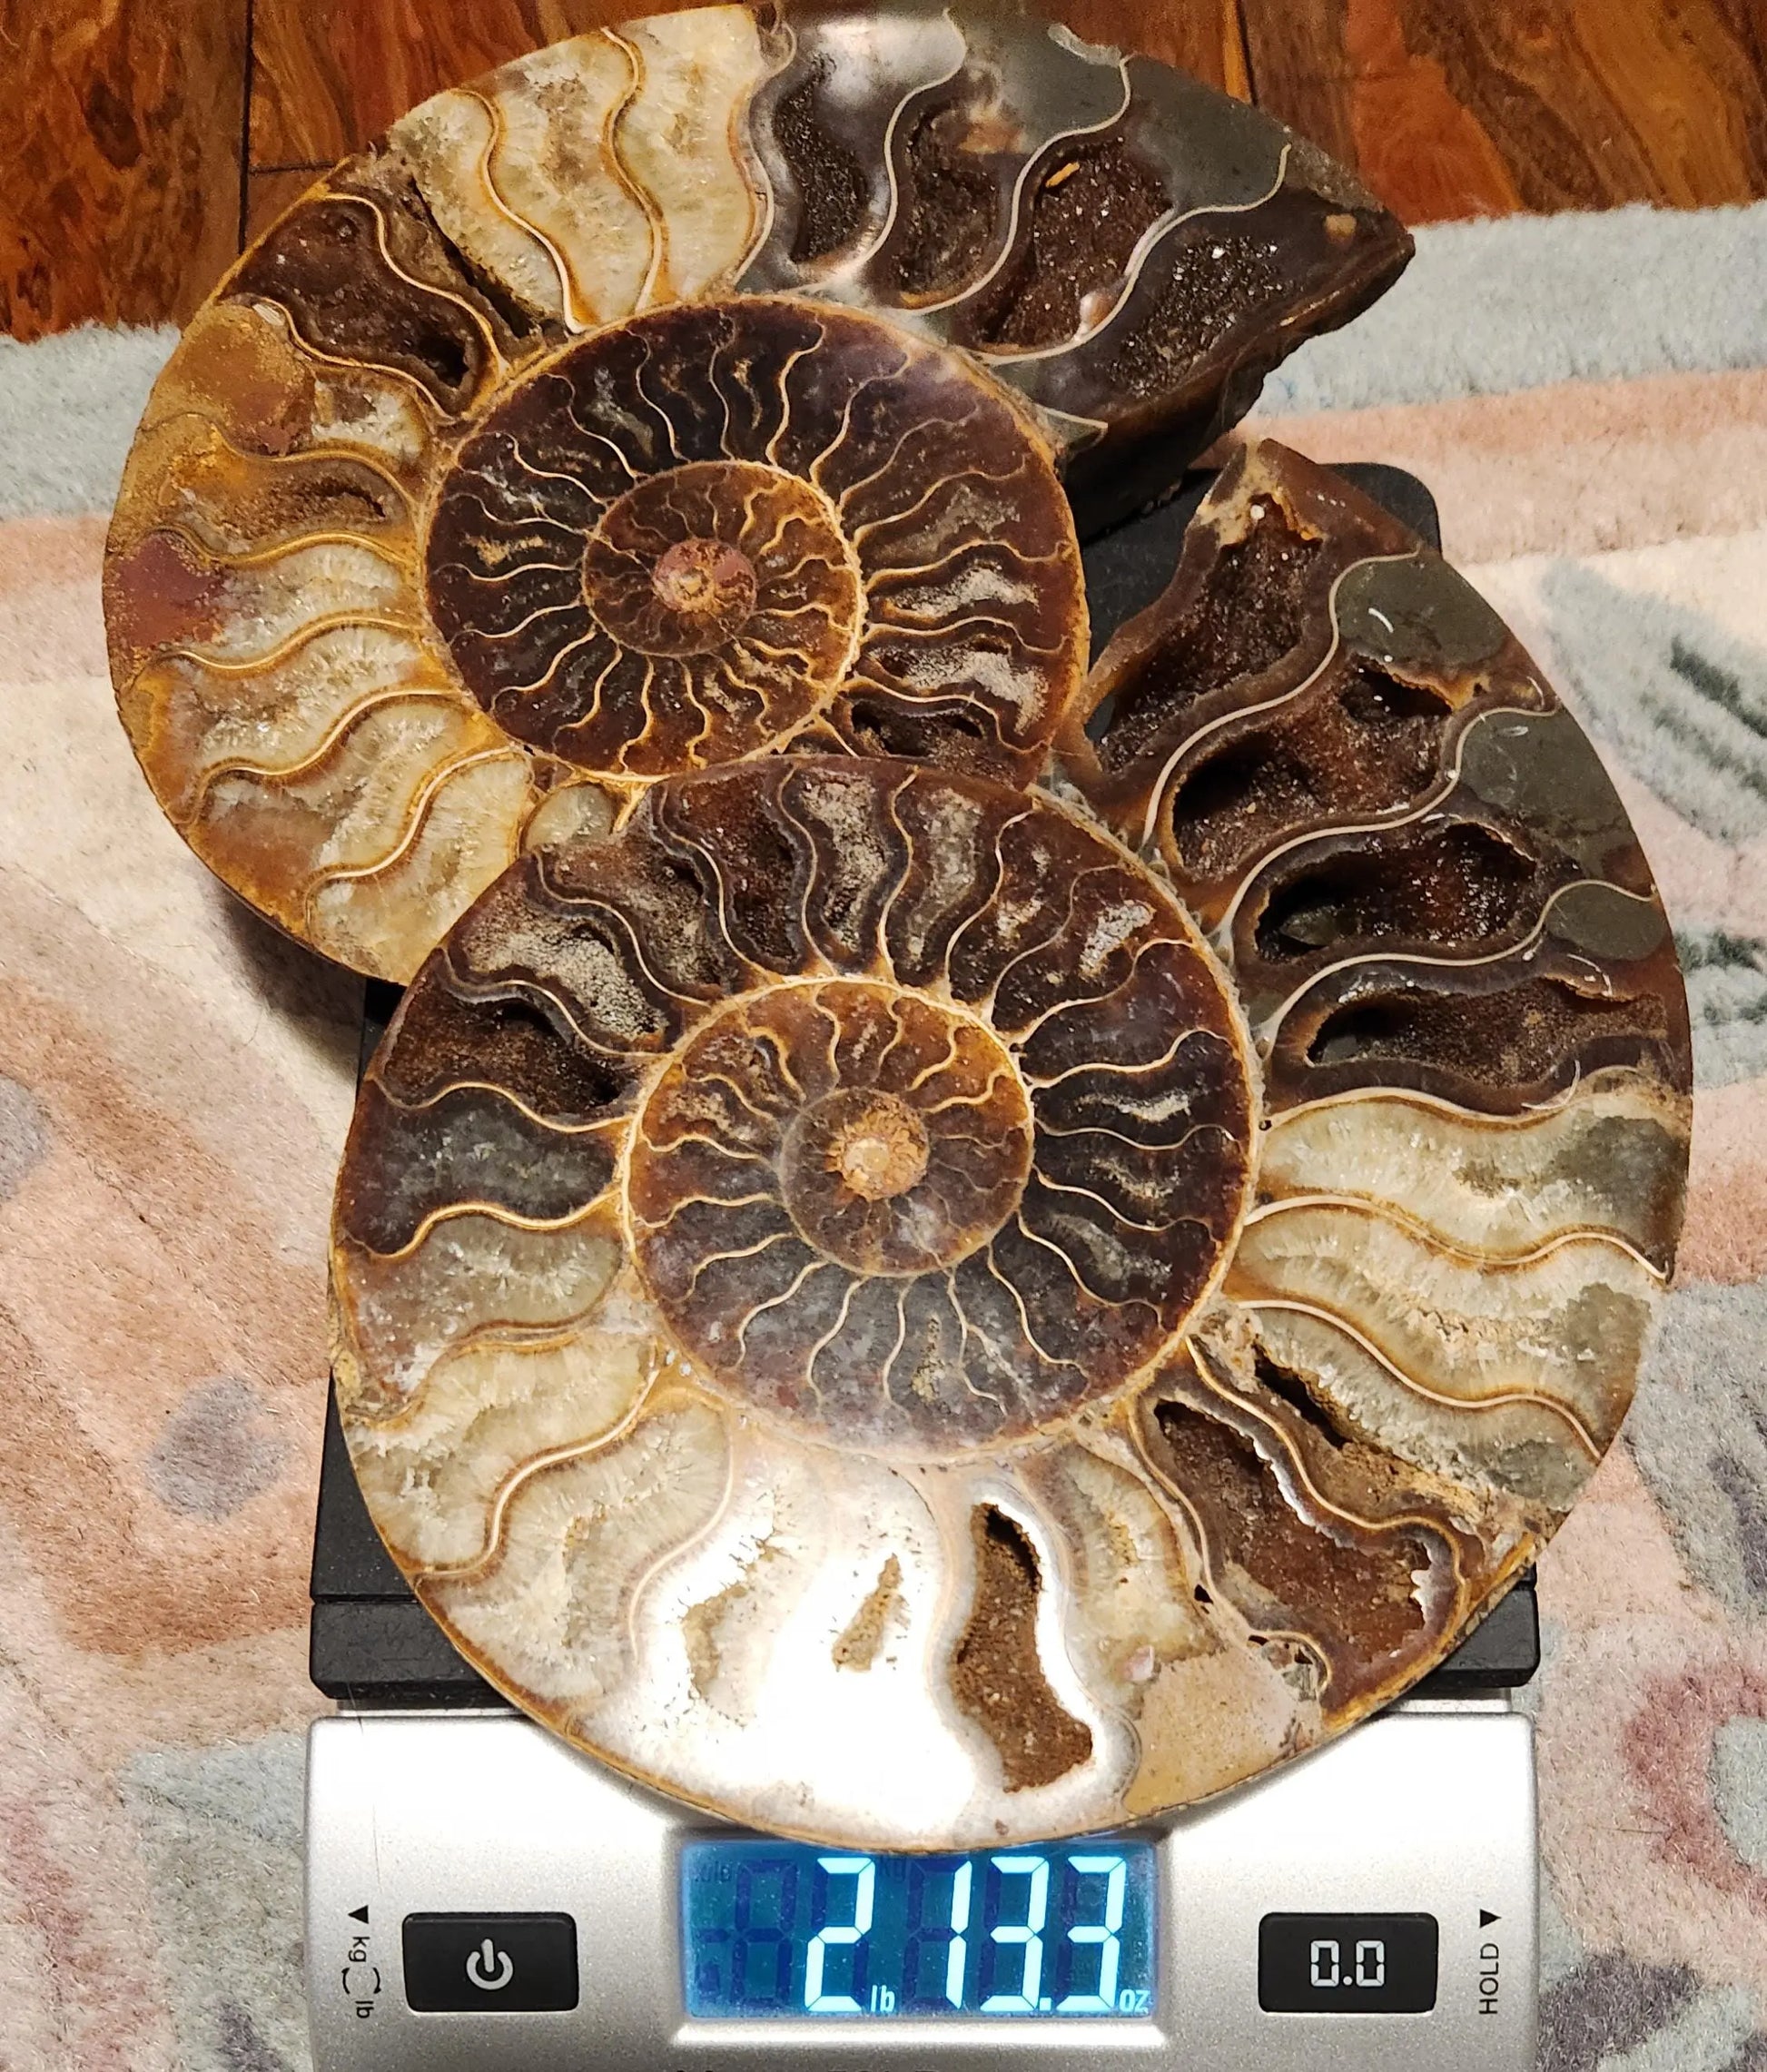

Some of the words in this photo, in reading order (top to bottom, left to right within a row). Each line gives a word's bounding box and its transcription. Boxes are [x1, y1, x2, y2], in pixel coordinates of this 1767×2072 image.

[348, 1936, 370, 1962] kg
[805, 1857, 875, 2012] 2
[870, 1985, 895, 2012] lb
[945, 1856, 1126, 2012] 13.3
[1310, 1939, 1385, 1988] 0.0
[1479, 1943, 1499, 2015] HOLD
[355, 2000, 374, 2018] lb
